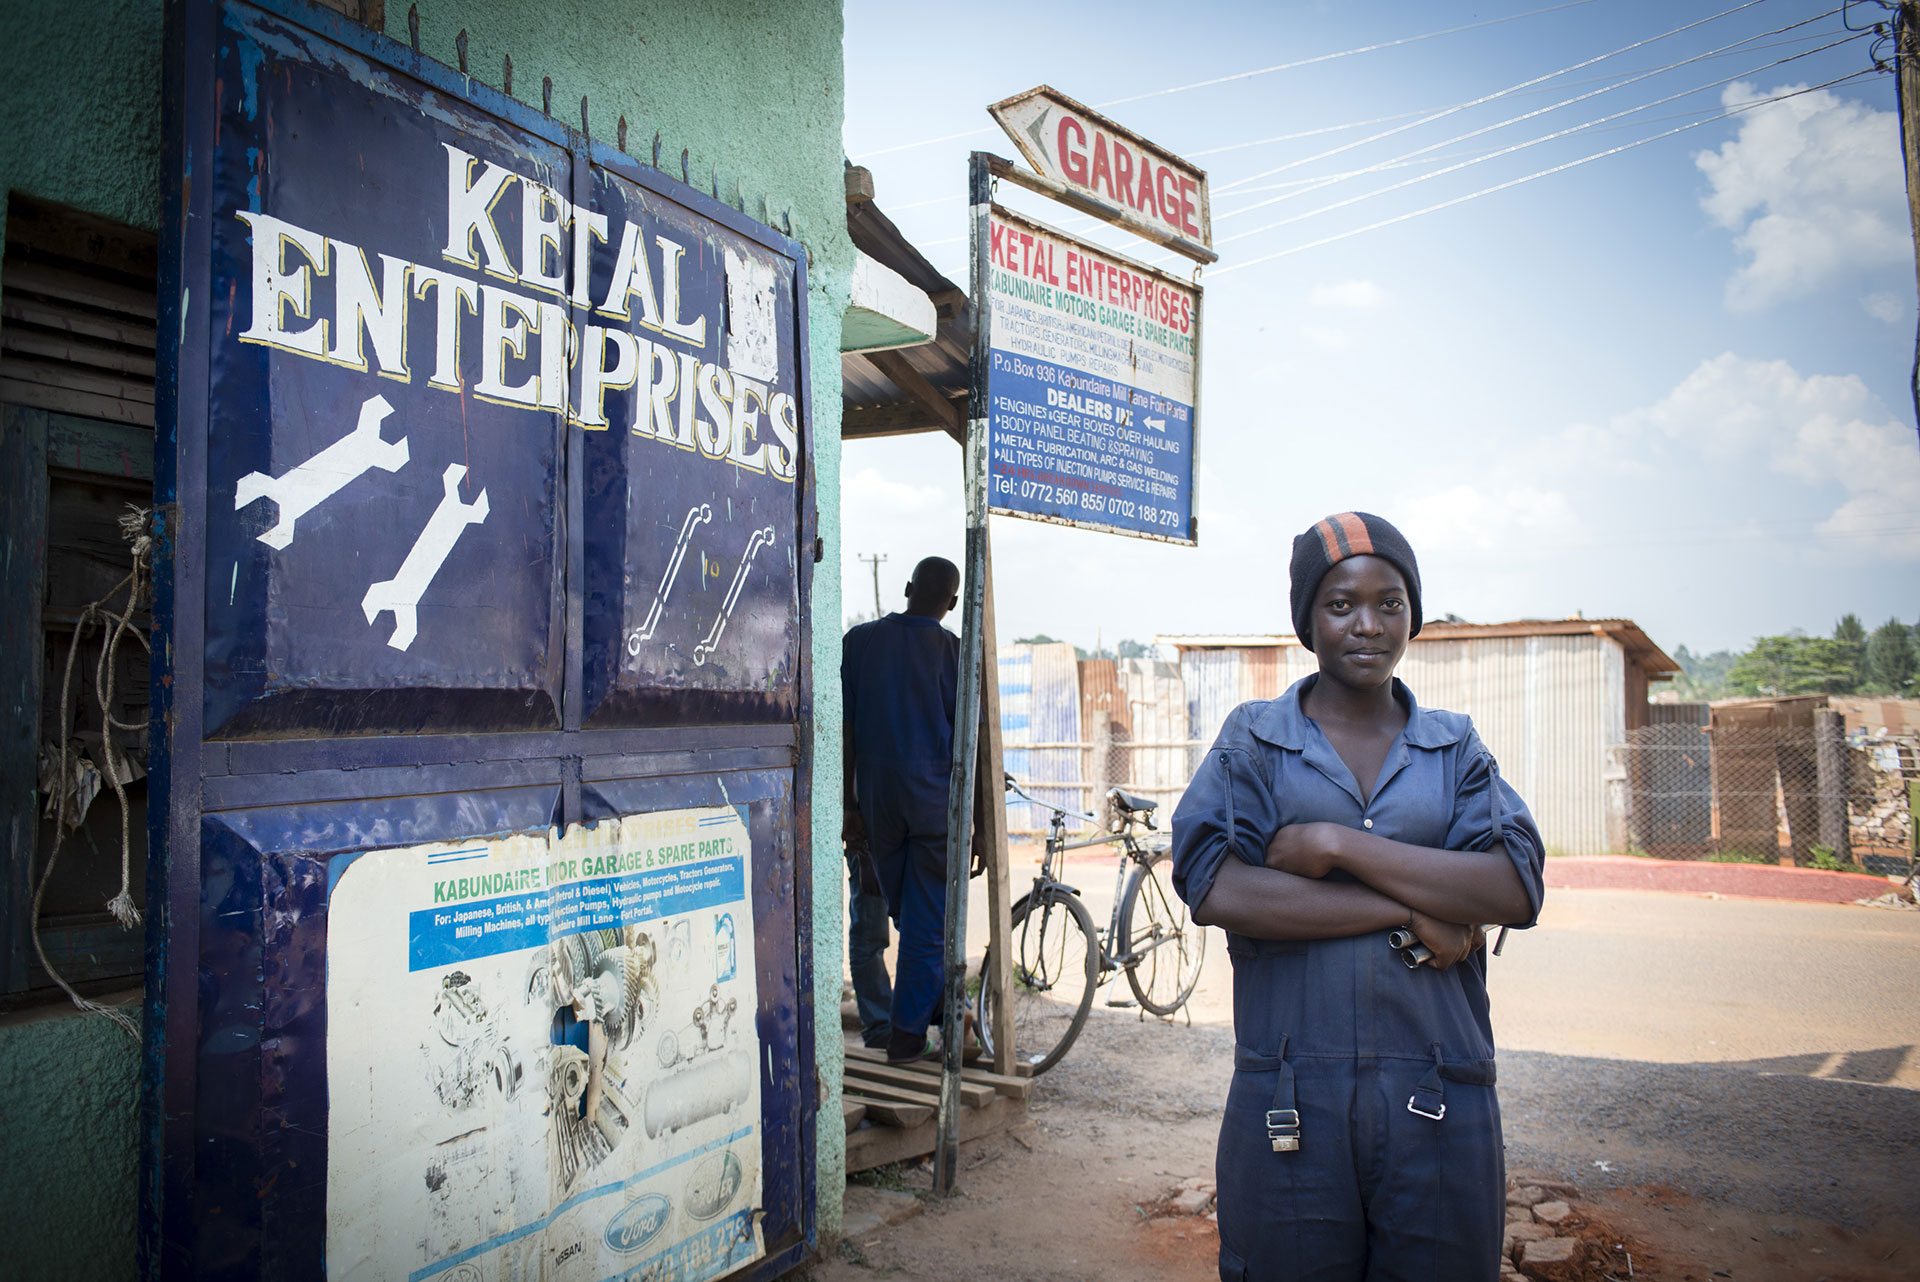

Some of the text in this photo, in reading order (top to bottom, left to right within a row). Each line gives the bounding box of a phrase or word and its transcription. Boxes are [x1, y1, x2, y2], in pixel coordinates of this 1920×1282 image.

[1057, 115, 1199, 239] GARAGE
[441, 142, 705, 347] KETAL
[990, 220, 1190, 334] KETAL ENTERPRISES
[234, 210, 798, 483] ENTERPRISES
[1055, 290, 1096, 322] MOTORS
[1099, 305, 1135, 335] GARAGE
[1137, 319, 1142, 337] &
[1144, 321, 1168, 347] SPARE
[1169, 331, 1195, 357] PARTS
[1011, 336, 1056, 359] HYDRAULIC
[1060, 349, 1086, 367] PUMPS
[1036, 364, 1055, 383] 936
[1057, 369, 1111, 397] Kabundaire
[1112, 383, 1127, 401] Mill
[1166, 401, 1188, 421] Portal
[1047, 387, 1133, 427] DEALERS IN:
[1000, 396, 1047, 419] ENGINES
[1083, 417, 1115, 437] BOXES
[1116, 427, 1141, 444] OVER
[1143, 433, 1180, 454] HAULING
[1001, 415, 1031, 434] BODY
[1033, 421, 1065, 441] PANEL
[1067, 428, 1106, 451] BEATING
[1000, 463, 1016, 476] 24
[1000, 448, 1177, 501] ALL TYPES OF INJECTION PUMPS SERVICE & REPAIRS
[1001, 433, 1179, 486] METAL FUBRICATION, ARC & GAS WELDING
[993, 474, 1018, 495] Tel:
[1021, 480, 1053, 503] 0772
[1055, 487, 1078, 505] 560
[1081, 492, 1106, 512] 855/
[1108, 498, 1135, 518] 0702
[1138, 504, 1157, 523] 188
[1159, 509, 1179, 528] 279
[582, 850, 642, 876] GARAGE
[646, 848, 654, 867] &
[658, 842, 695, 865] SPARE
[698, 837, 733, 858] PARTS
[435, 914, 452, 926] For:
[453, 908, 494, 924] Japanese,
[496, 900, 524, 916] British,
[526, 899, 532, 910] &
[575, 887, 580, 897] &
[582, 883, 611, 897] Diesel)
[613, 880, 642, 893] Vehicles,
[642, 872, 679, 887] Motorcycles,
[680, 868, 703, 880] Tractors
[456, 925, 482, 939] Milling
[484, 918, 524, 933] Machines,
[525, 914, 536, 926] all
[580, 900, 610, 912] Pumps,
[642, 890, 662, 903] pumps
[663, 886, 674, 897] and
[577, 915, 590, 927] Mill
[593, 914, 614, 925] Lane
[620, 909, 632, 920] Fort
[620, 1208, 658, 1246] Ford
[679, 1234, 712, 1273] 188
[555, 1241, 582, 1267] NISSAN
